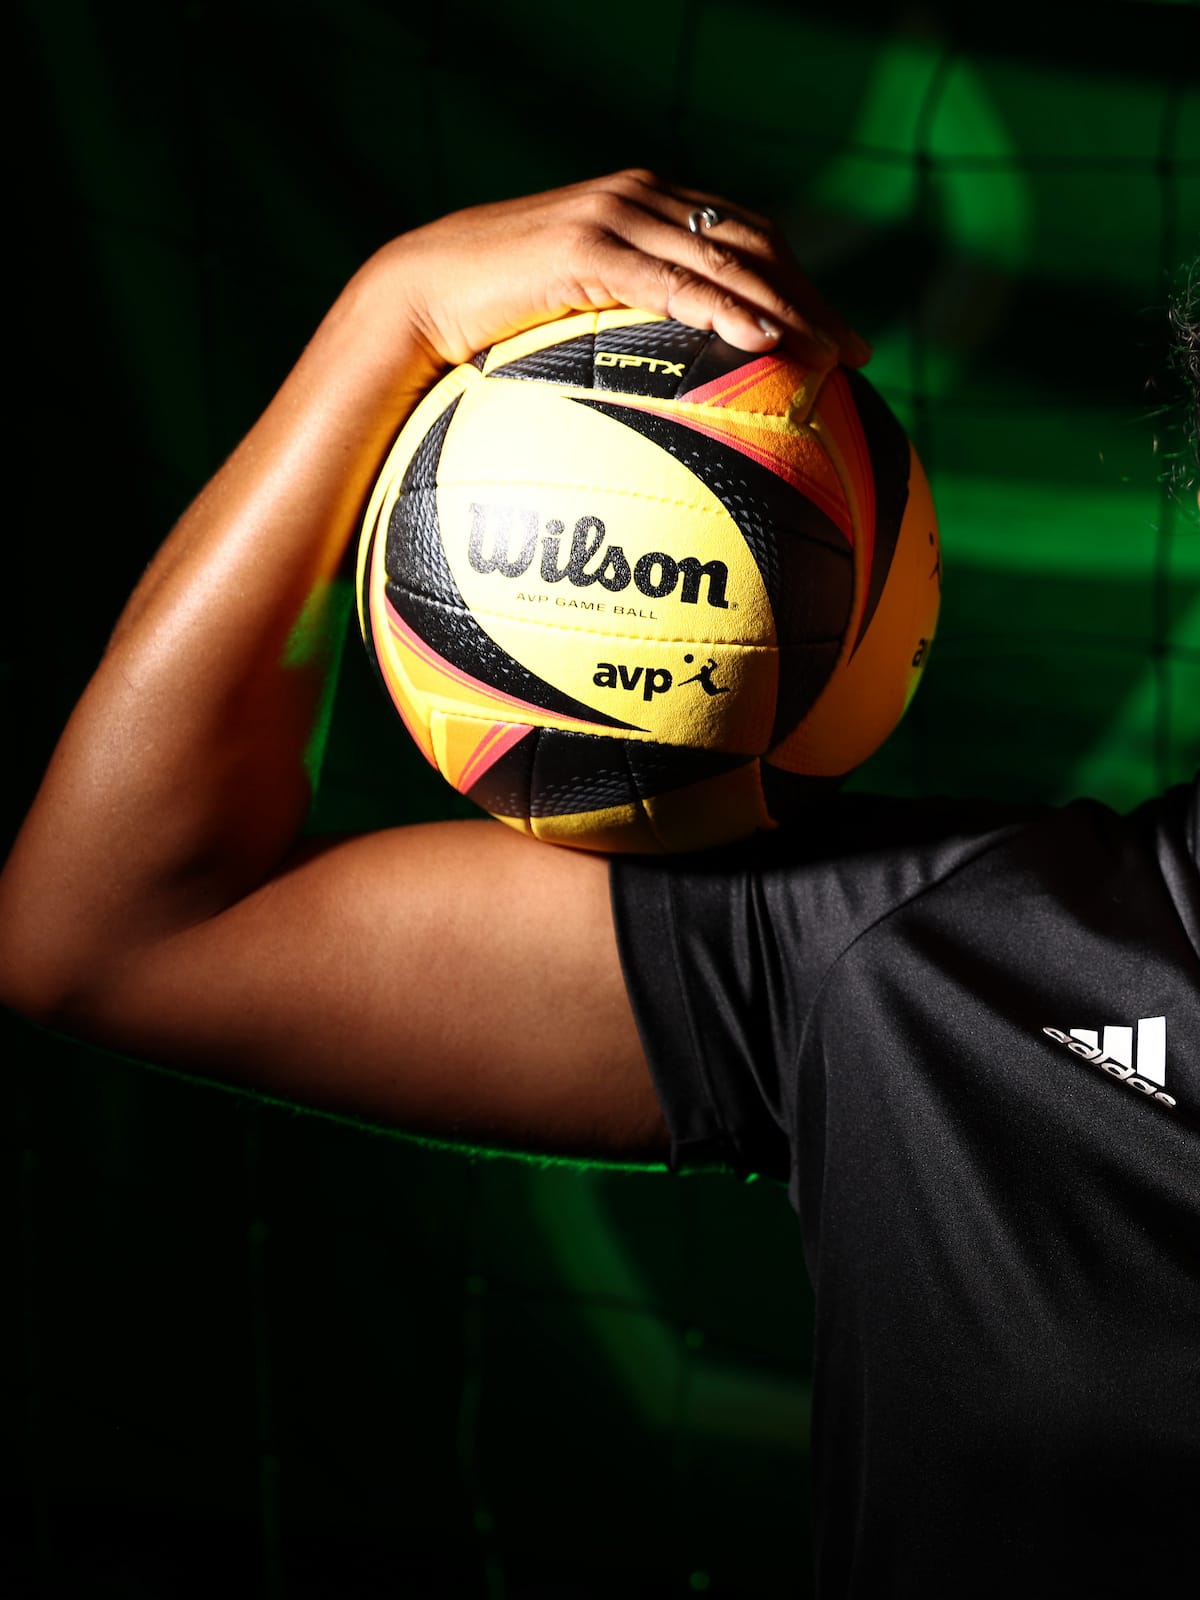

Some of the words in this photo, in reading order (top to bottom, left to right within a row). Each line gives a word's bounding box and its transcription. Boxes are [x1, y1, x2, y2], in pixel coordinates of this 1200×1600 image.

[594, 351, 685, 377] OPTX
[467, 502, 729, 609] Wilson
[516, 591, 549, 604] AVP
[555, 597, 606, 612] GAME
[613, 605, 658, 620] BALL
[592, 662, 673, 702] avp
[1042, 1026, 1177, 1109] adidas
